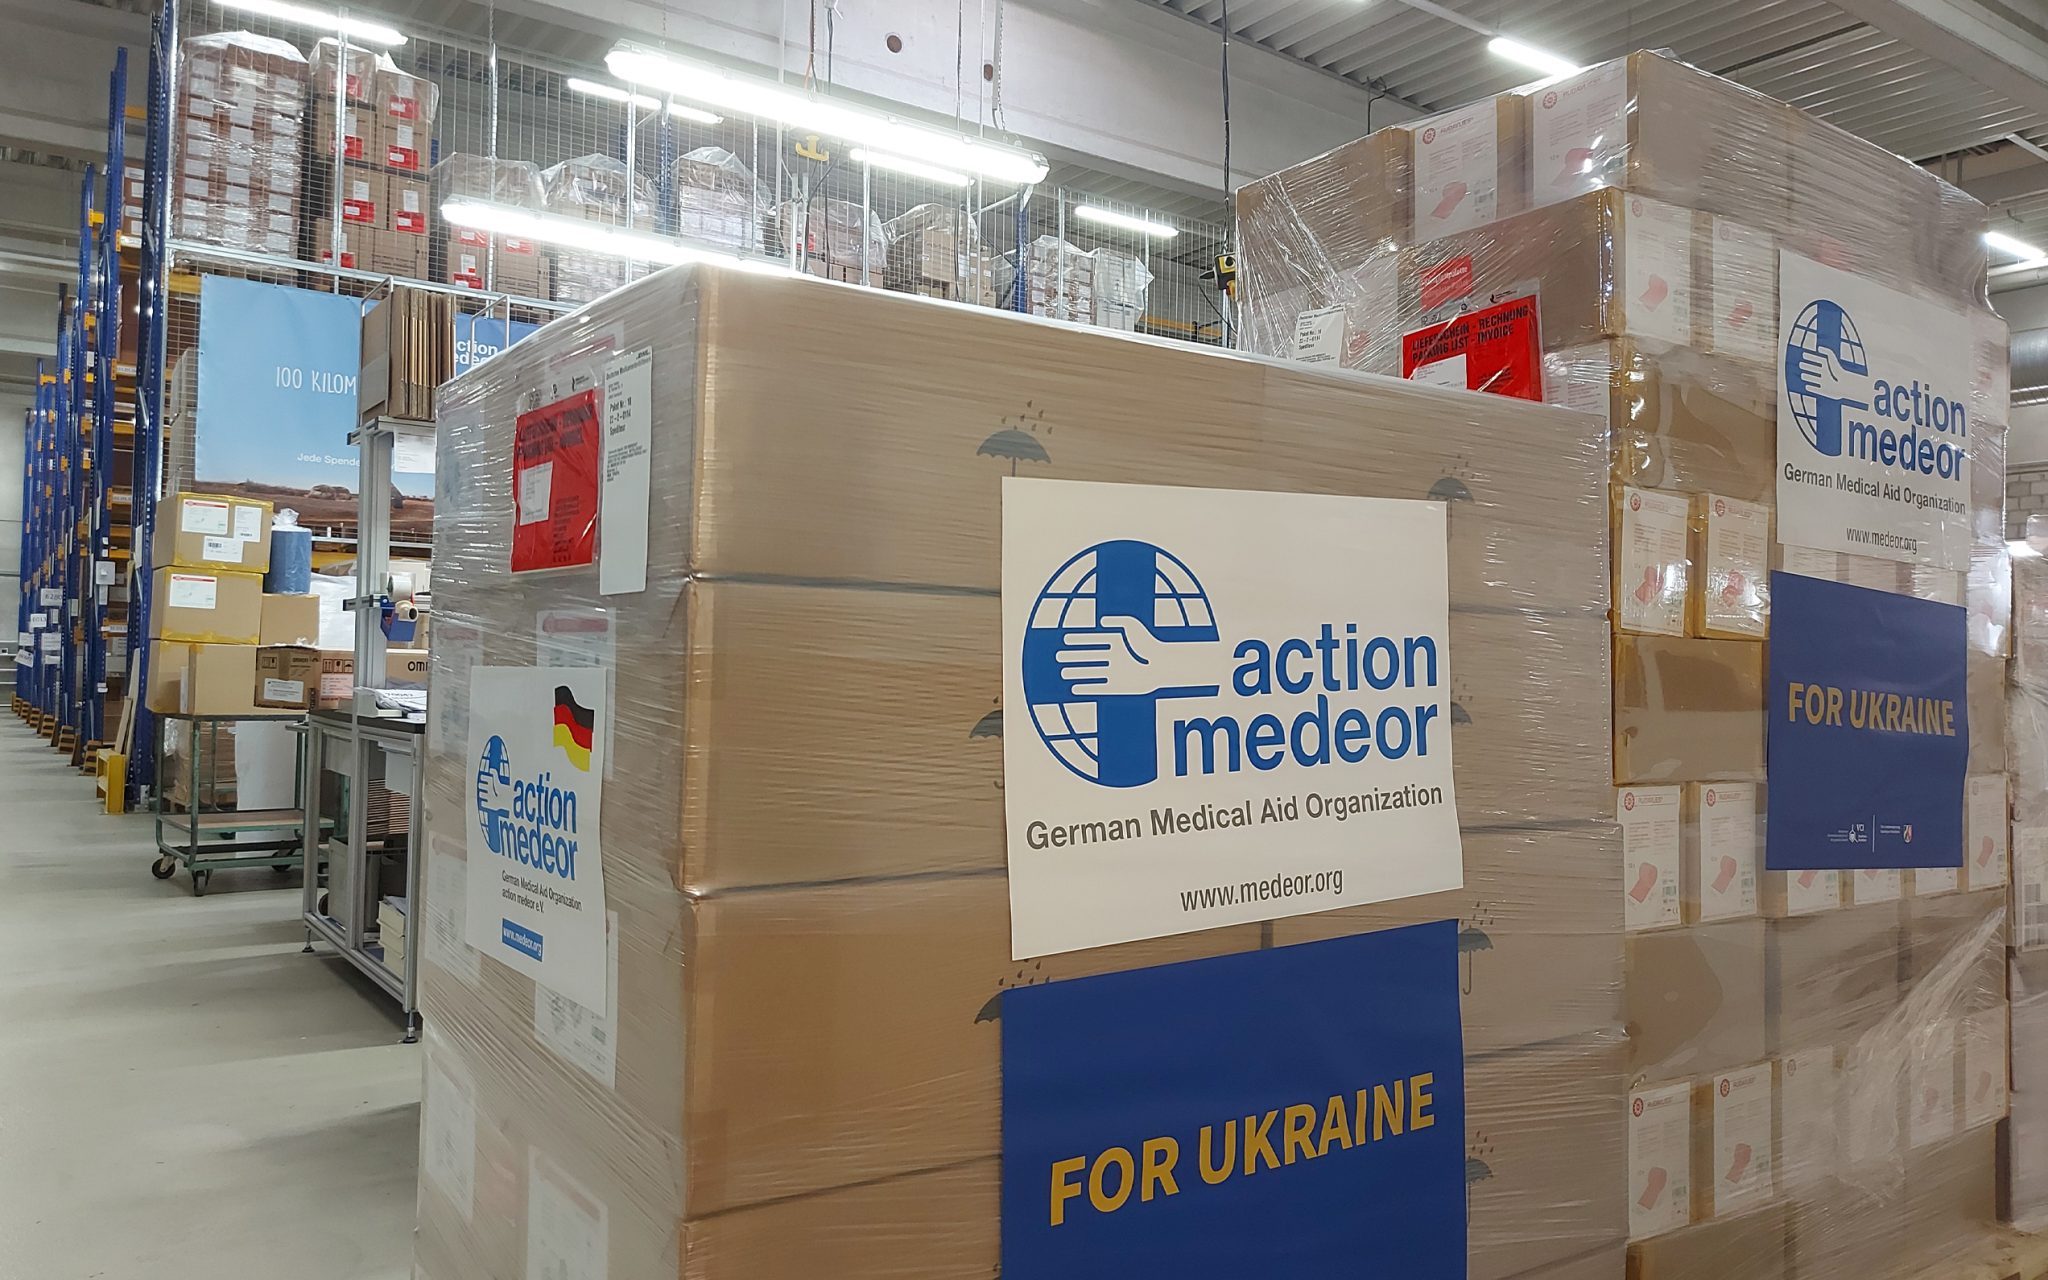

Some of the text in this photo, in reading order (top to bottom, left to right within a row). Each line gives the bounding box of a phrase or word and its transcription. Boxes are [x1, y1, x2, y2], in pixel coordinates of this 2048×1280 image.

[1451, 336, 1468, 350] LIST
[1478, 324, 1513, 343] INVOICE
[1479, 305, 1528, 329] RECHNUNG
[457, 340, 498, 355] ction
[276, 366, 302, 389] 100
[1873, 380, 1966, 437] action
[297, 453, 322, 463] Jede
[1848, 425, 1966, 482] medeor
[1784, 462, 1966, 515] German Medical Aid Organization
[1846, 527, 1917, 554] www.medeor.org
[407, 661, 428, 672] OM
[1232, 623, 1438, 697] action
[1788, 682, 1956, 737] FOR UKRAINE
[1173, 694, 1438, 777] medeor
[513, 772, 577, 834] action
[1026, 784, 1443, 850] German Medical Aid Organization
[500, 816, 578, 881] medeor
[502, 869, 582, 912] German Medical Aid Organization
[502, 888, 516, 901] action
[517, 893, 535, 910] medeor
[1180, 869, 1343, 911] www.medeor.org
[503, 927, 542, 957] www.medeor.org
[1050, 1072, 1435, 1227] FOR UKRAINE
